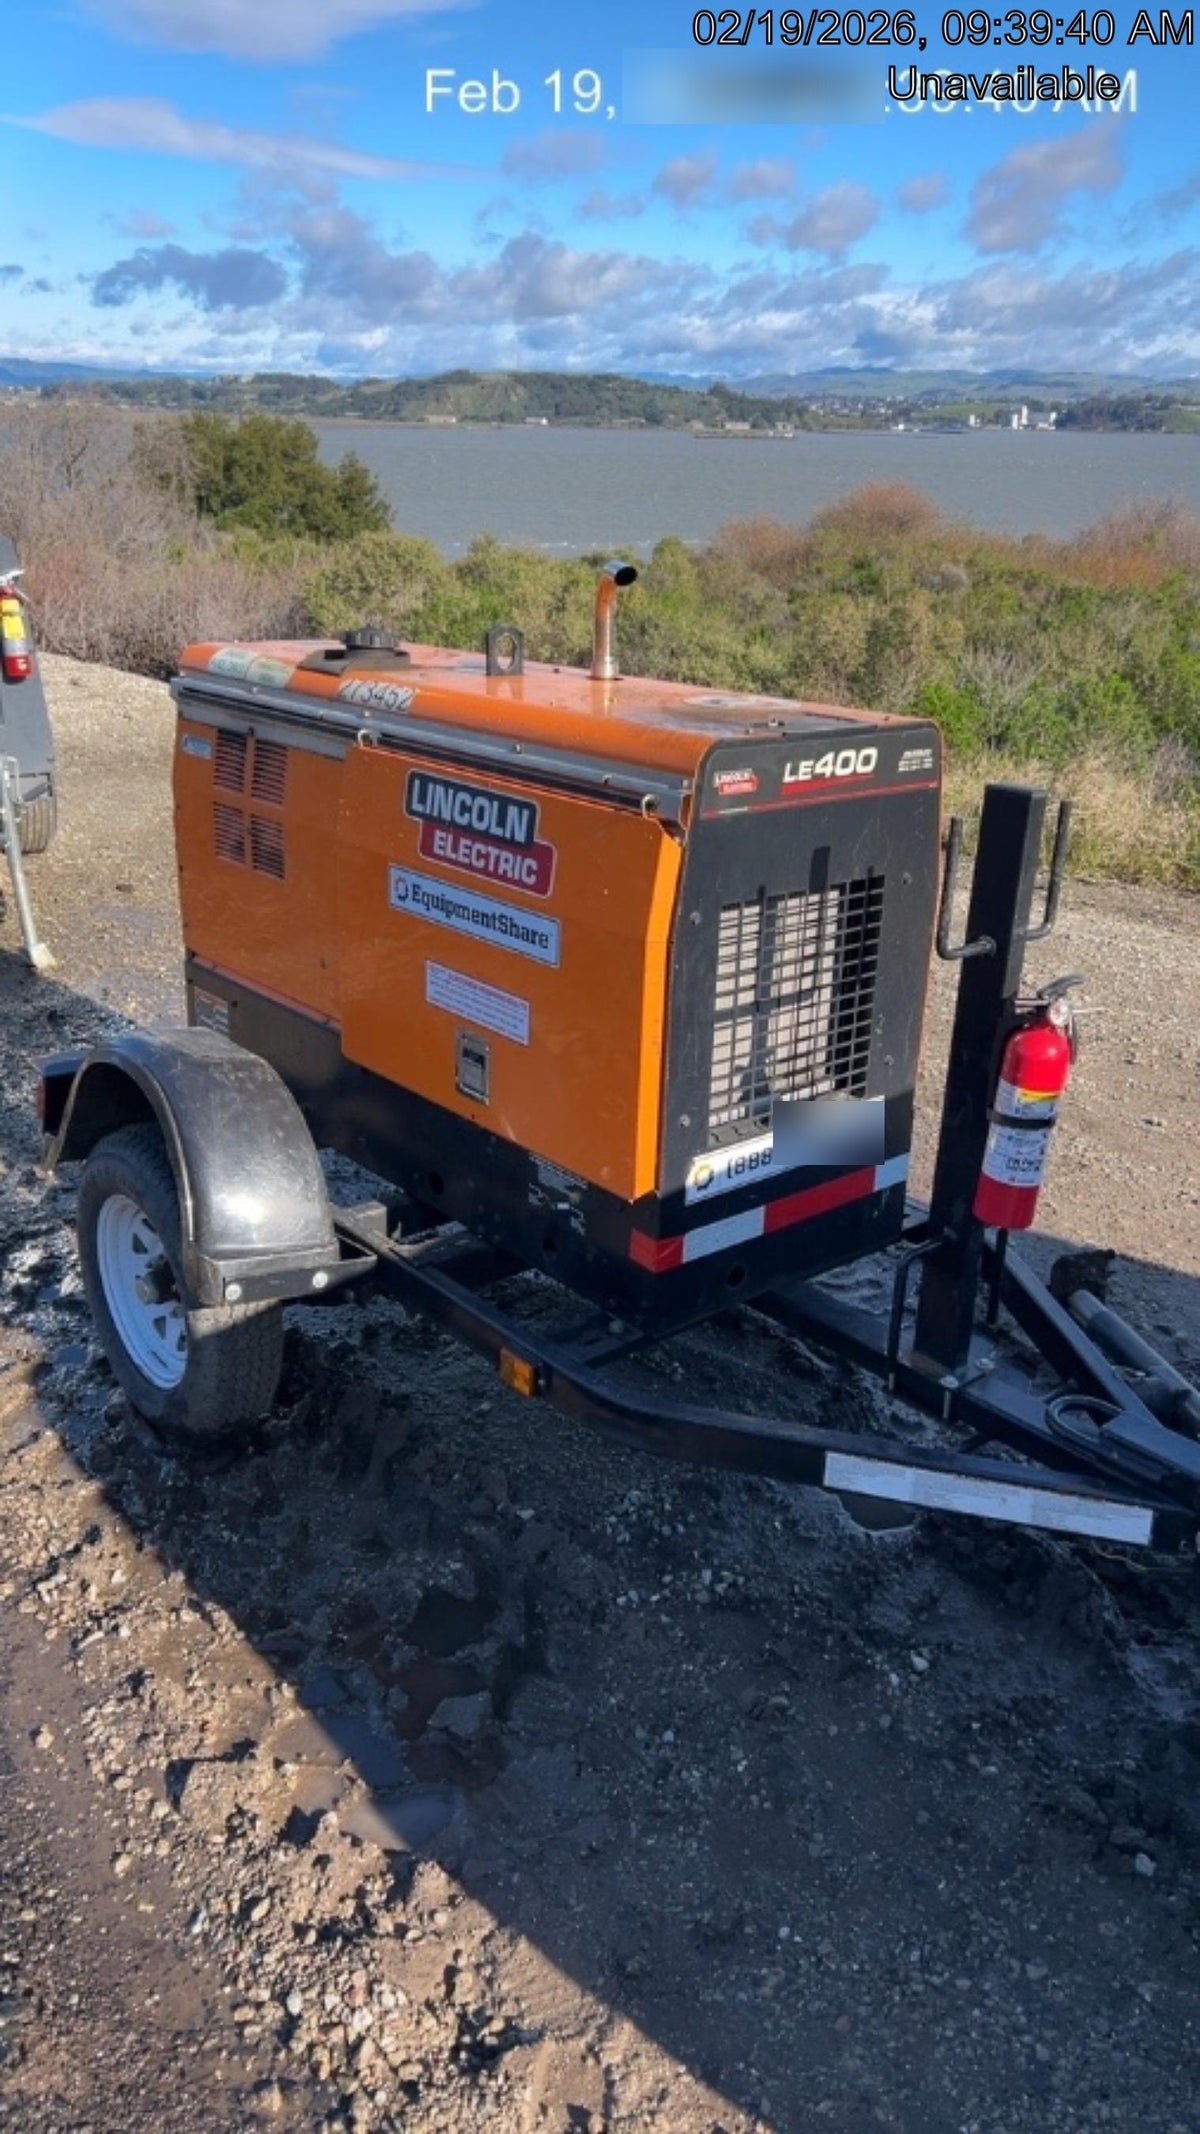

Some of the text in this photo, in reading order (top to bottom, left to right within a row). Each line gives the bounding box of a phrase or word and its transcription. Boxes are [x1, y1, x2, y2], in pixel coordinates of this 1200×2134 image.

[782, 746, 878, 784] LE400
[411, 778, 530, 844] LINCOLN
[432, 831, 538, 886] ELECTRIC
[411, 883, 550, 950] EquipmentShare
